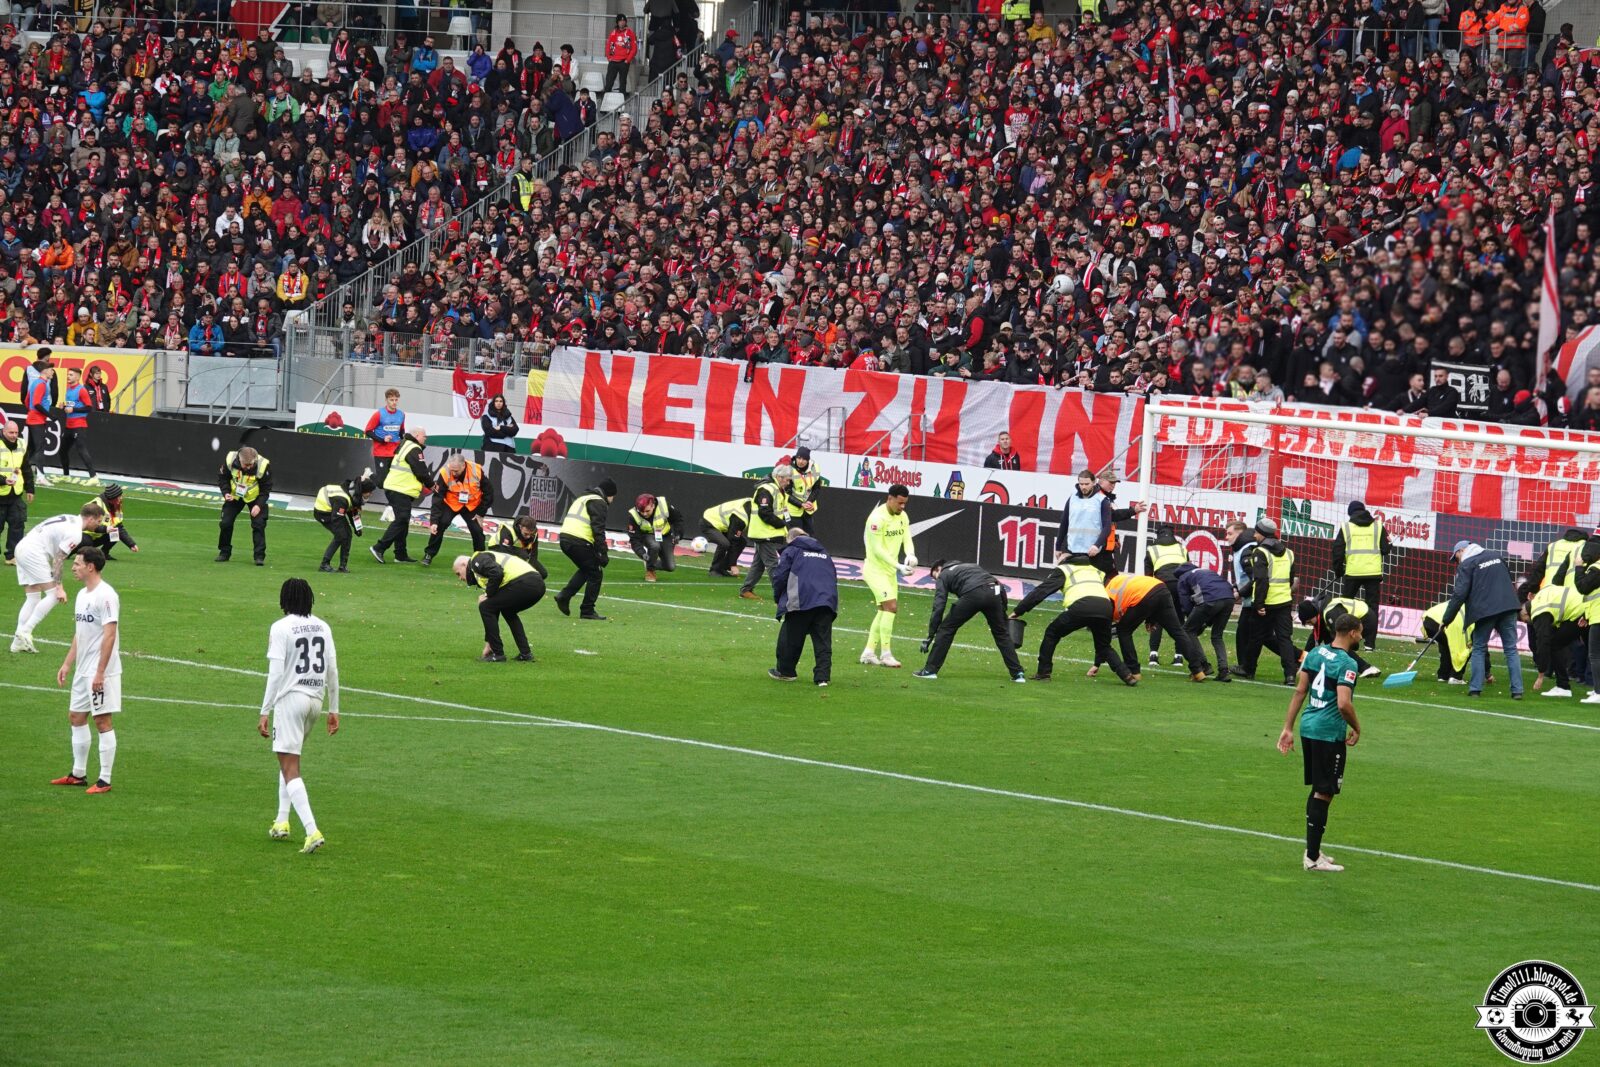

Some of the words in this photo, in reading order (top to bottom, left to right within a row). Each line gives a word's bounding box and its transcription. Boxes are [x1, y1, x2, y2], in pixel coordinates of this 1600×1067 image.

[579, 352, 806, 449] NEIN
[840, 369, 968, 464] ZU
[1156, 396, 1249, 443] FÜR
[1264, 407, 1423, 464] EINEN
[532, 478, 556, 492] ELEVEN
[874, 460, 922, 487] Rothaus
[803, 551, 828, 560] JOBRAD
[1479, 558, 1502, 570] JOBRAD
[295, 636, 325, 674] 33
[1311, 662, 1325, 698] 4
[92, 691, 105, 706] 27
